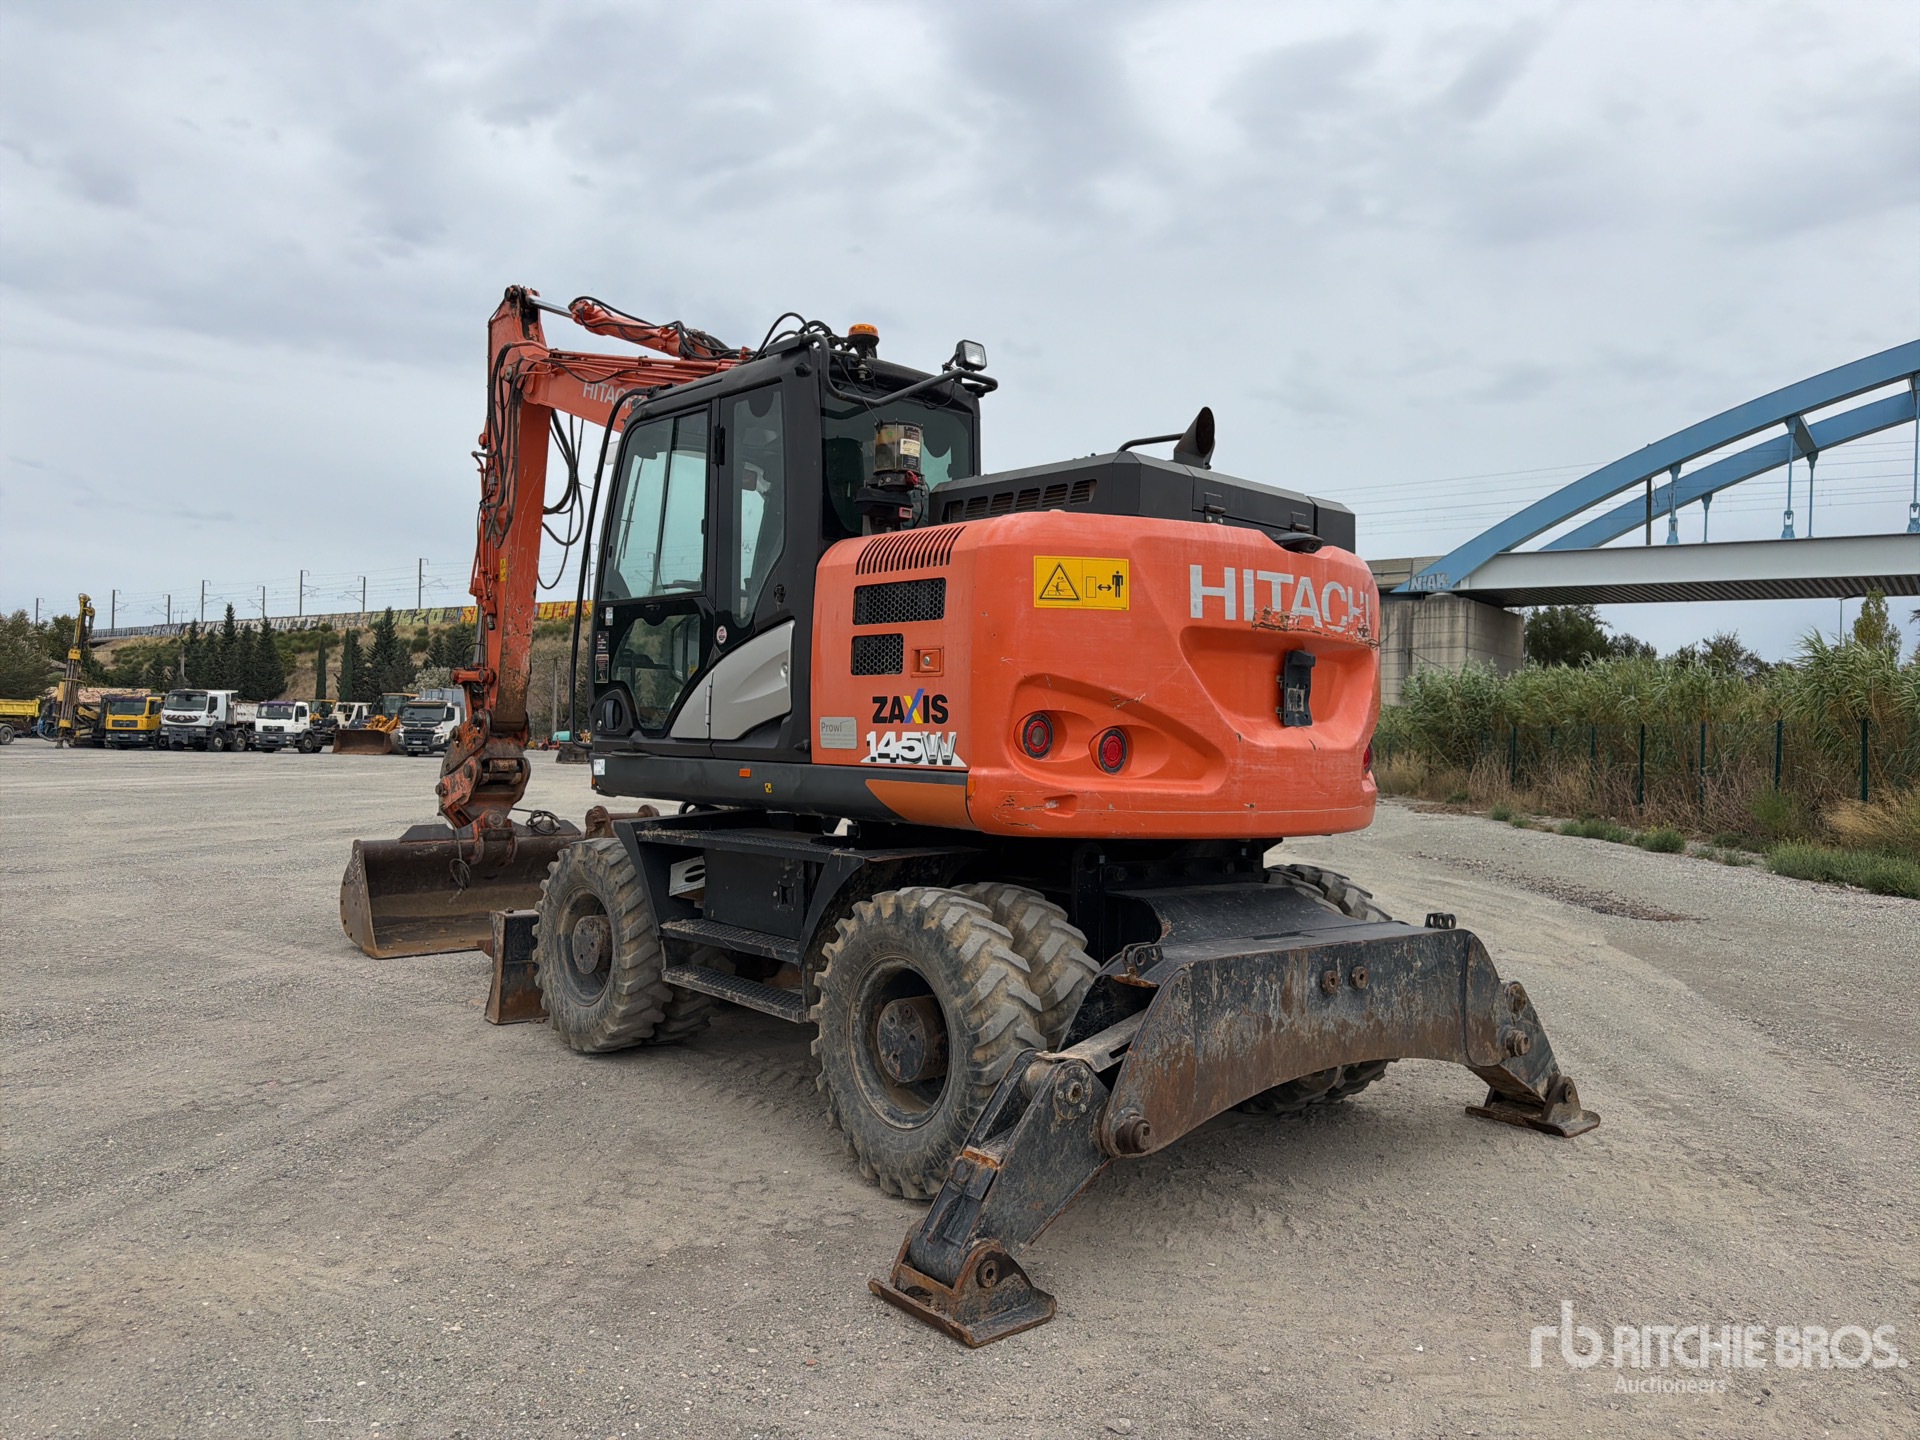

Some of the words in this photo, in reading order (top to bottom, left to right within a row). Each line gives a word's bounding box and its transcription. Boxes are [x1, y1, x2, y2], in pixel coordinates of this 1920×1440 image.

[1190, 564, 1371, 632] HITACHI
[872, 688, 949, 725] ZAXIS
[866, 731, 957, 766] 145W
